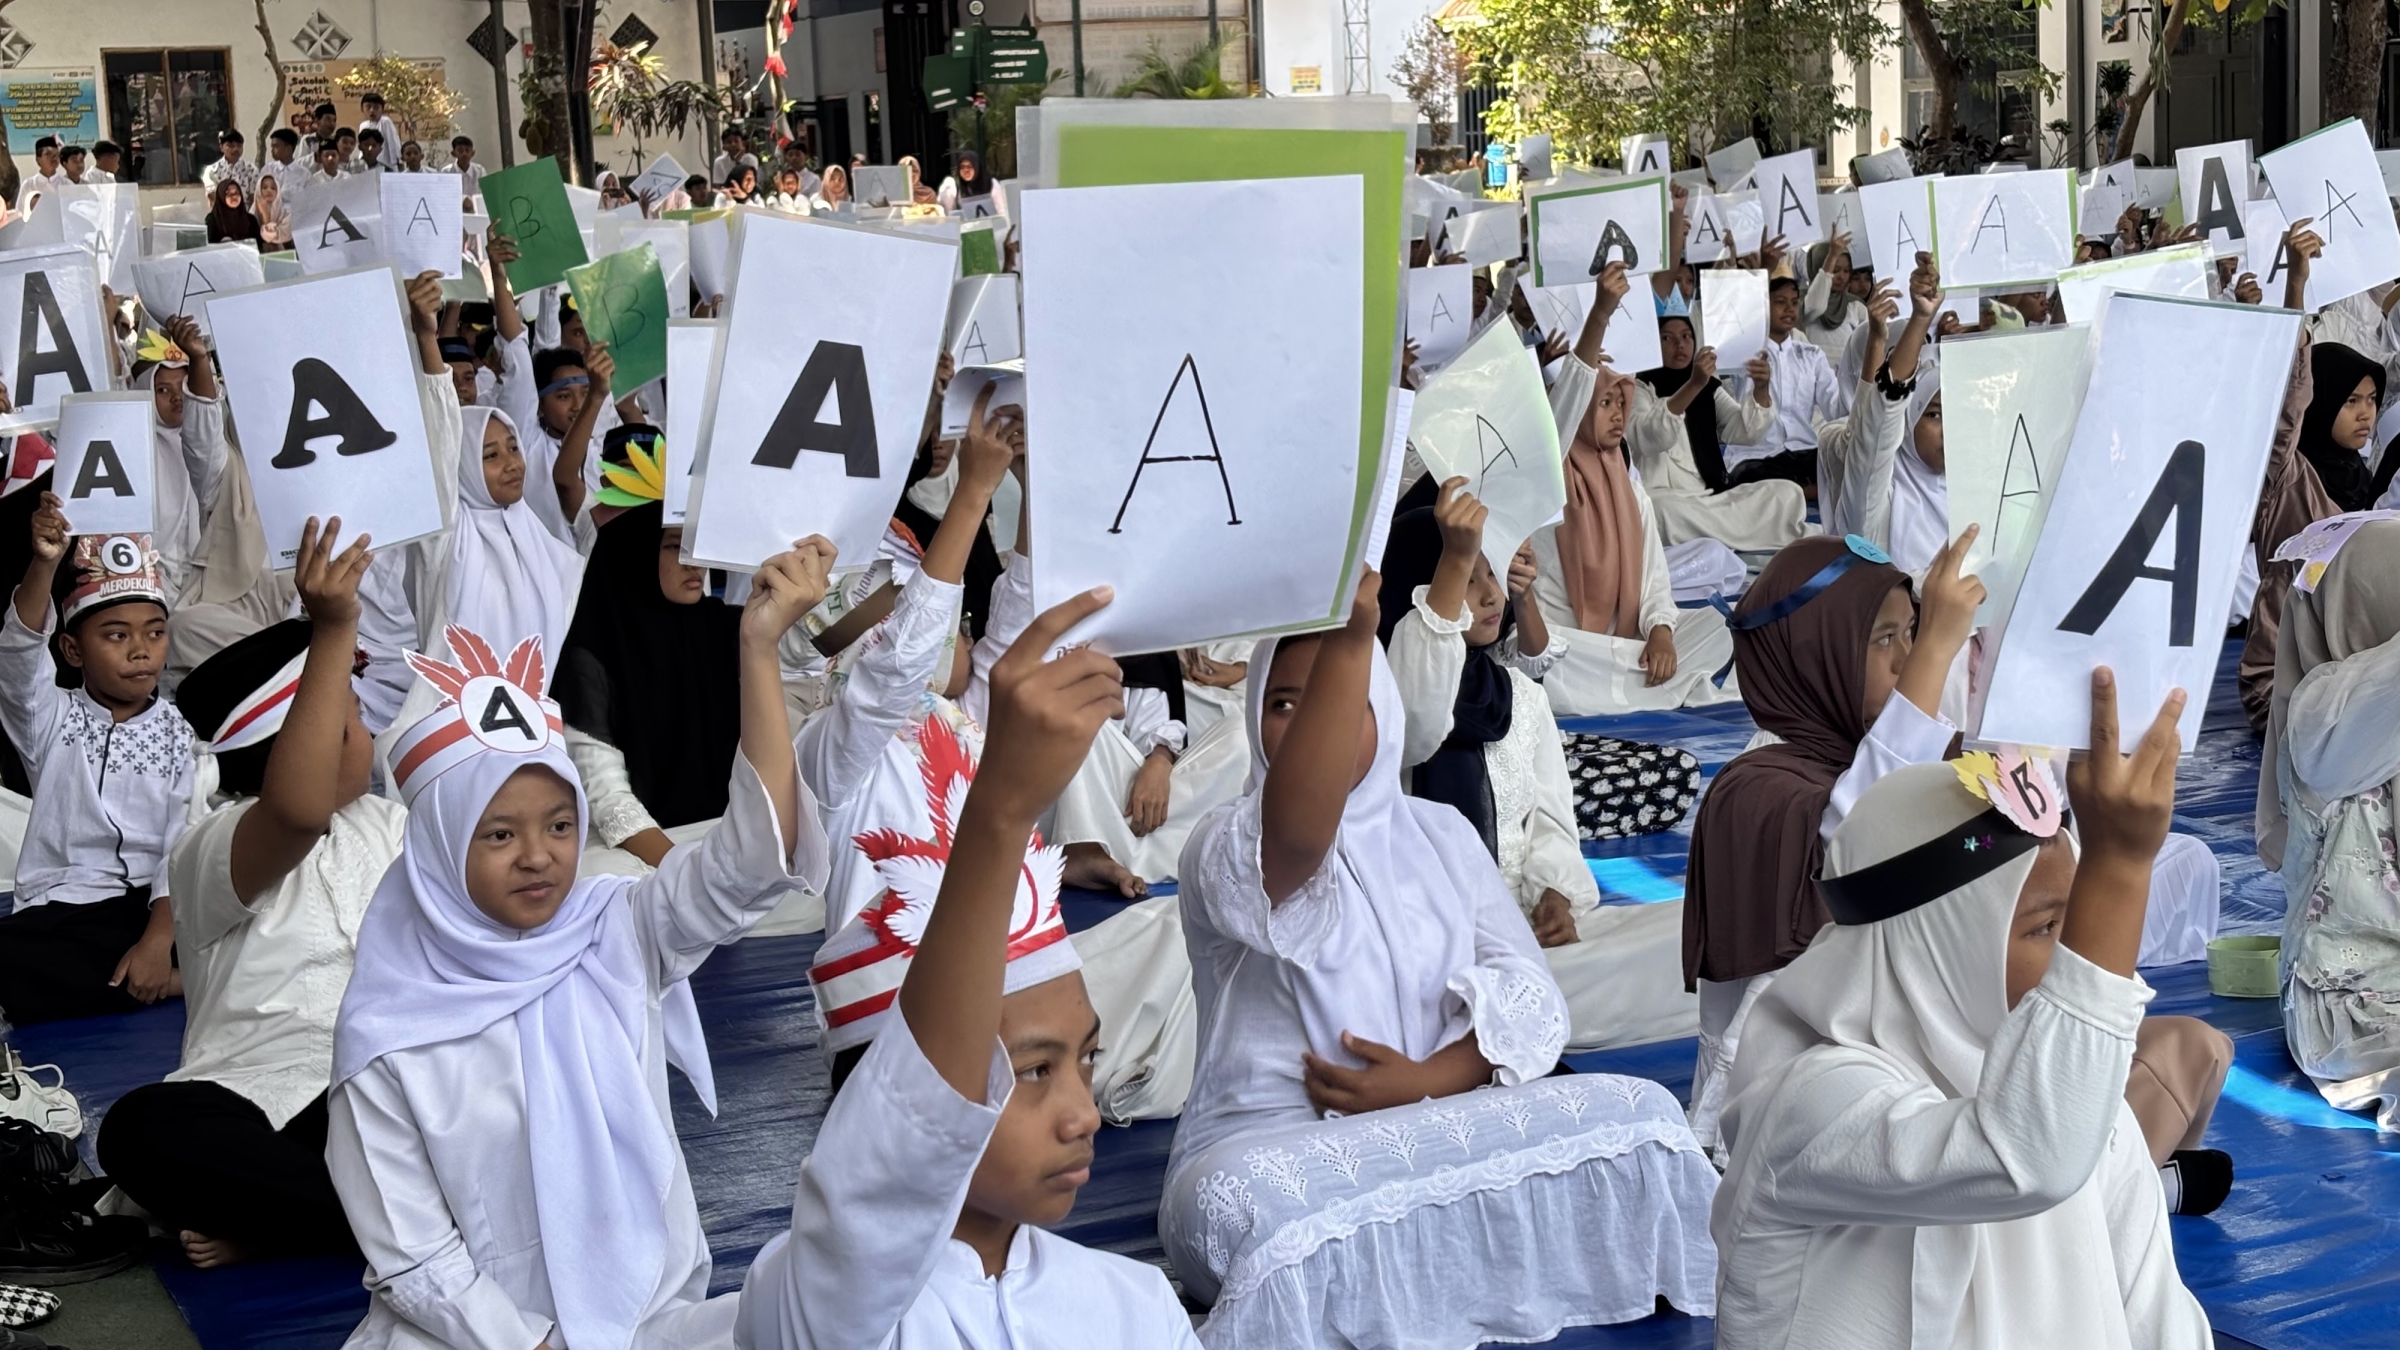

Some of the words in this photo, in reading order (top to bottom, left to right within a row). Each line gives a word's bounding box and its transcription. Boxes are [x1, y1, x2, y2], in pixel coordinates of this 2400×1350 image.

[316, 205, 369, 249] A
[405, 197, 439, 236] A
[509, 195, 541, 243] B
[1694, 210, 1722, 244] A
[1778, 173, 1812, 235] A
[1835, 202, 1849, 227] A
[1971, 193, 2009, 255] A
[2196, 157, 2245, 240] A
[2319, 179, 2364, 244] A
[1588, 219, 1639, 277] A
[1896, 210, 1919, 270] A
[178, 260, 216, 318] A
[602, 283, 646, 349] B
[1430, 293, 1454, 333] A
[14, 270, 93, 407] A
[961, 320, 989, 364] A
[270, 357, 398, 470] A
[750, 339, 881, 479] A
[70, 440, 136, 499] A
[1107, 353, 1243, 534] A
[1476, 413, 1519, 500] A
[1992, 413, 2041, 557] A
[111, 542, 134, 567] 6
[2055, 439, 2206, 648] A
[479, 685, 539, 741] A
